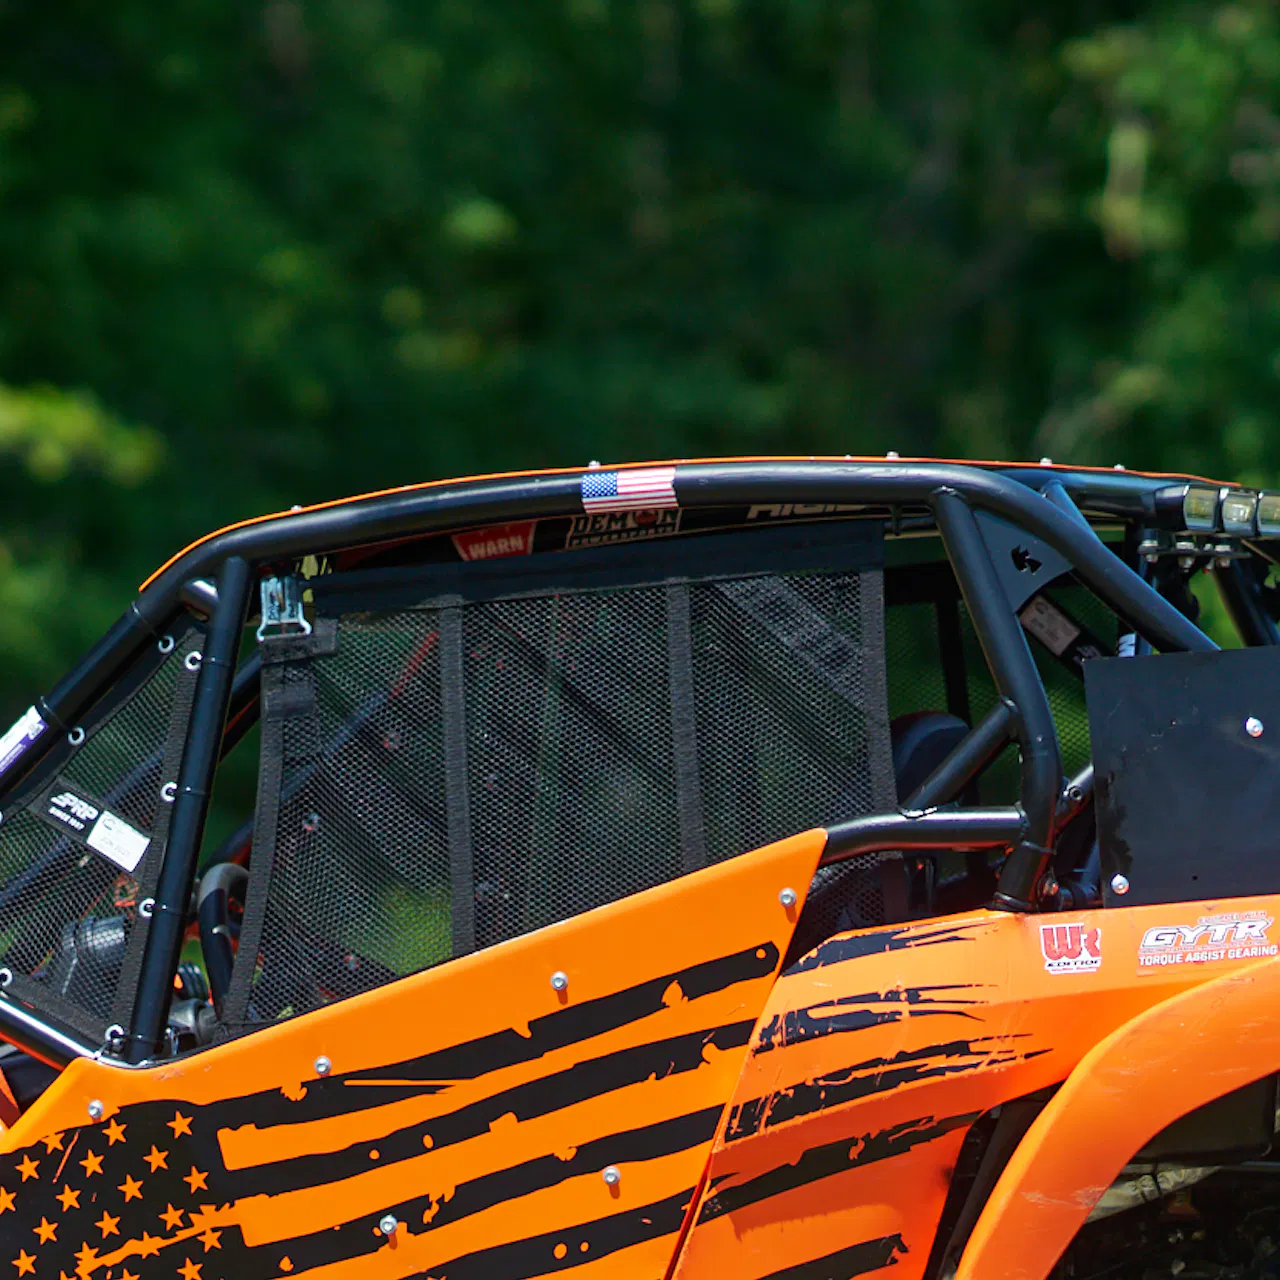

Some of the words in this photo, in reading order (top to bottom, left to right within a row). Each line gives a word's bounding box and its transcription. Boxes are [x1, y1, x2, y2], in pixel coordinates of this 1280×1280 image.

[468, 536, 524, 560] WARN
[50, 791, 99, 820] PRP
[1141, 918, 1270, 948] GYTR
[1139, 953, 1183, 966] TORQUE
[1185, 950, 1226, 963] ASSIST
[1227, 945, 1278, 959] GEARING
